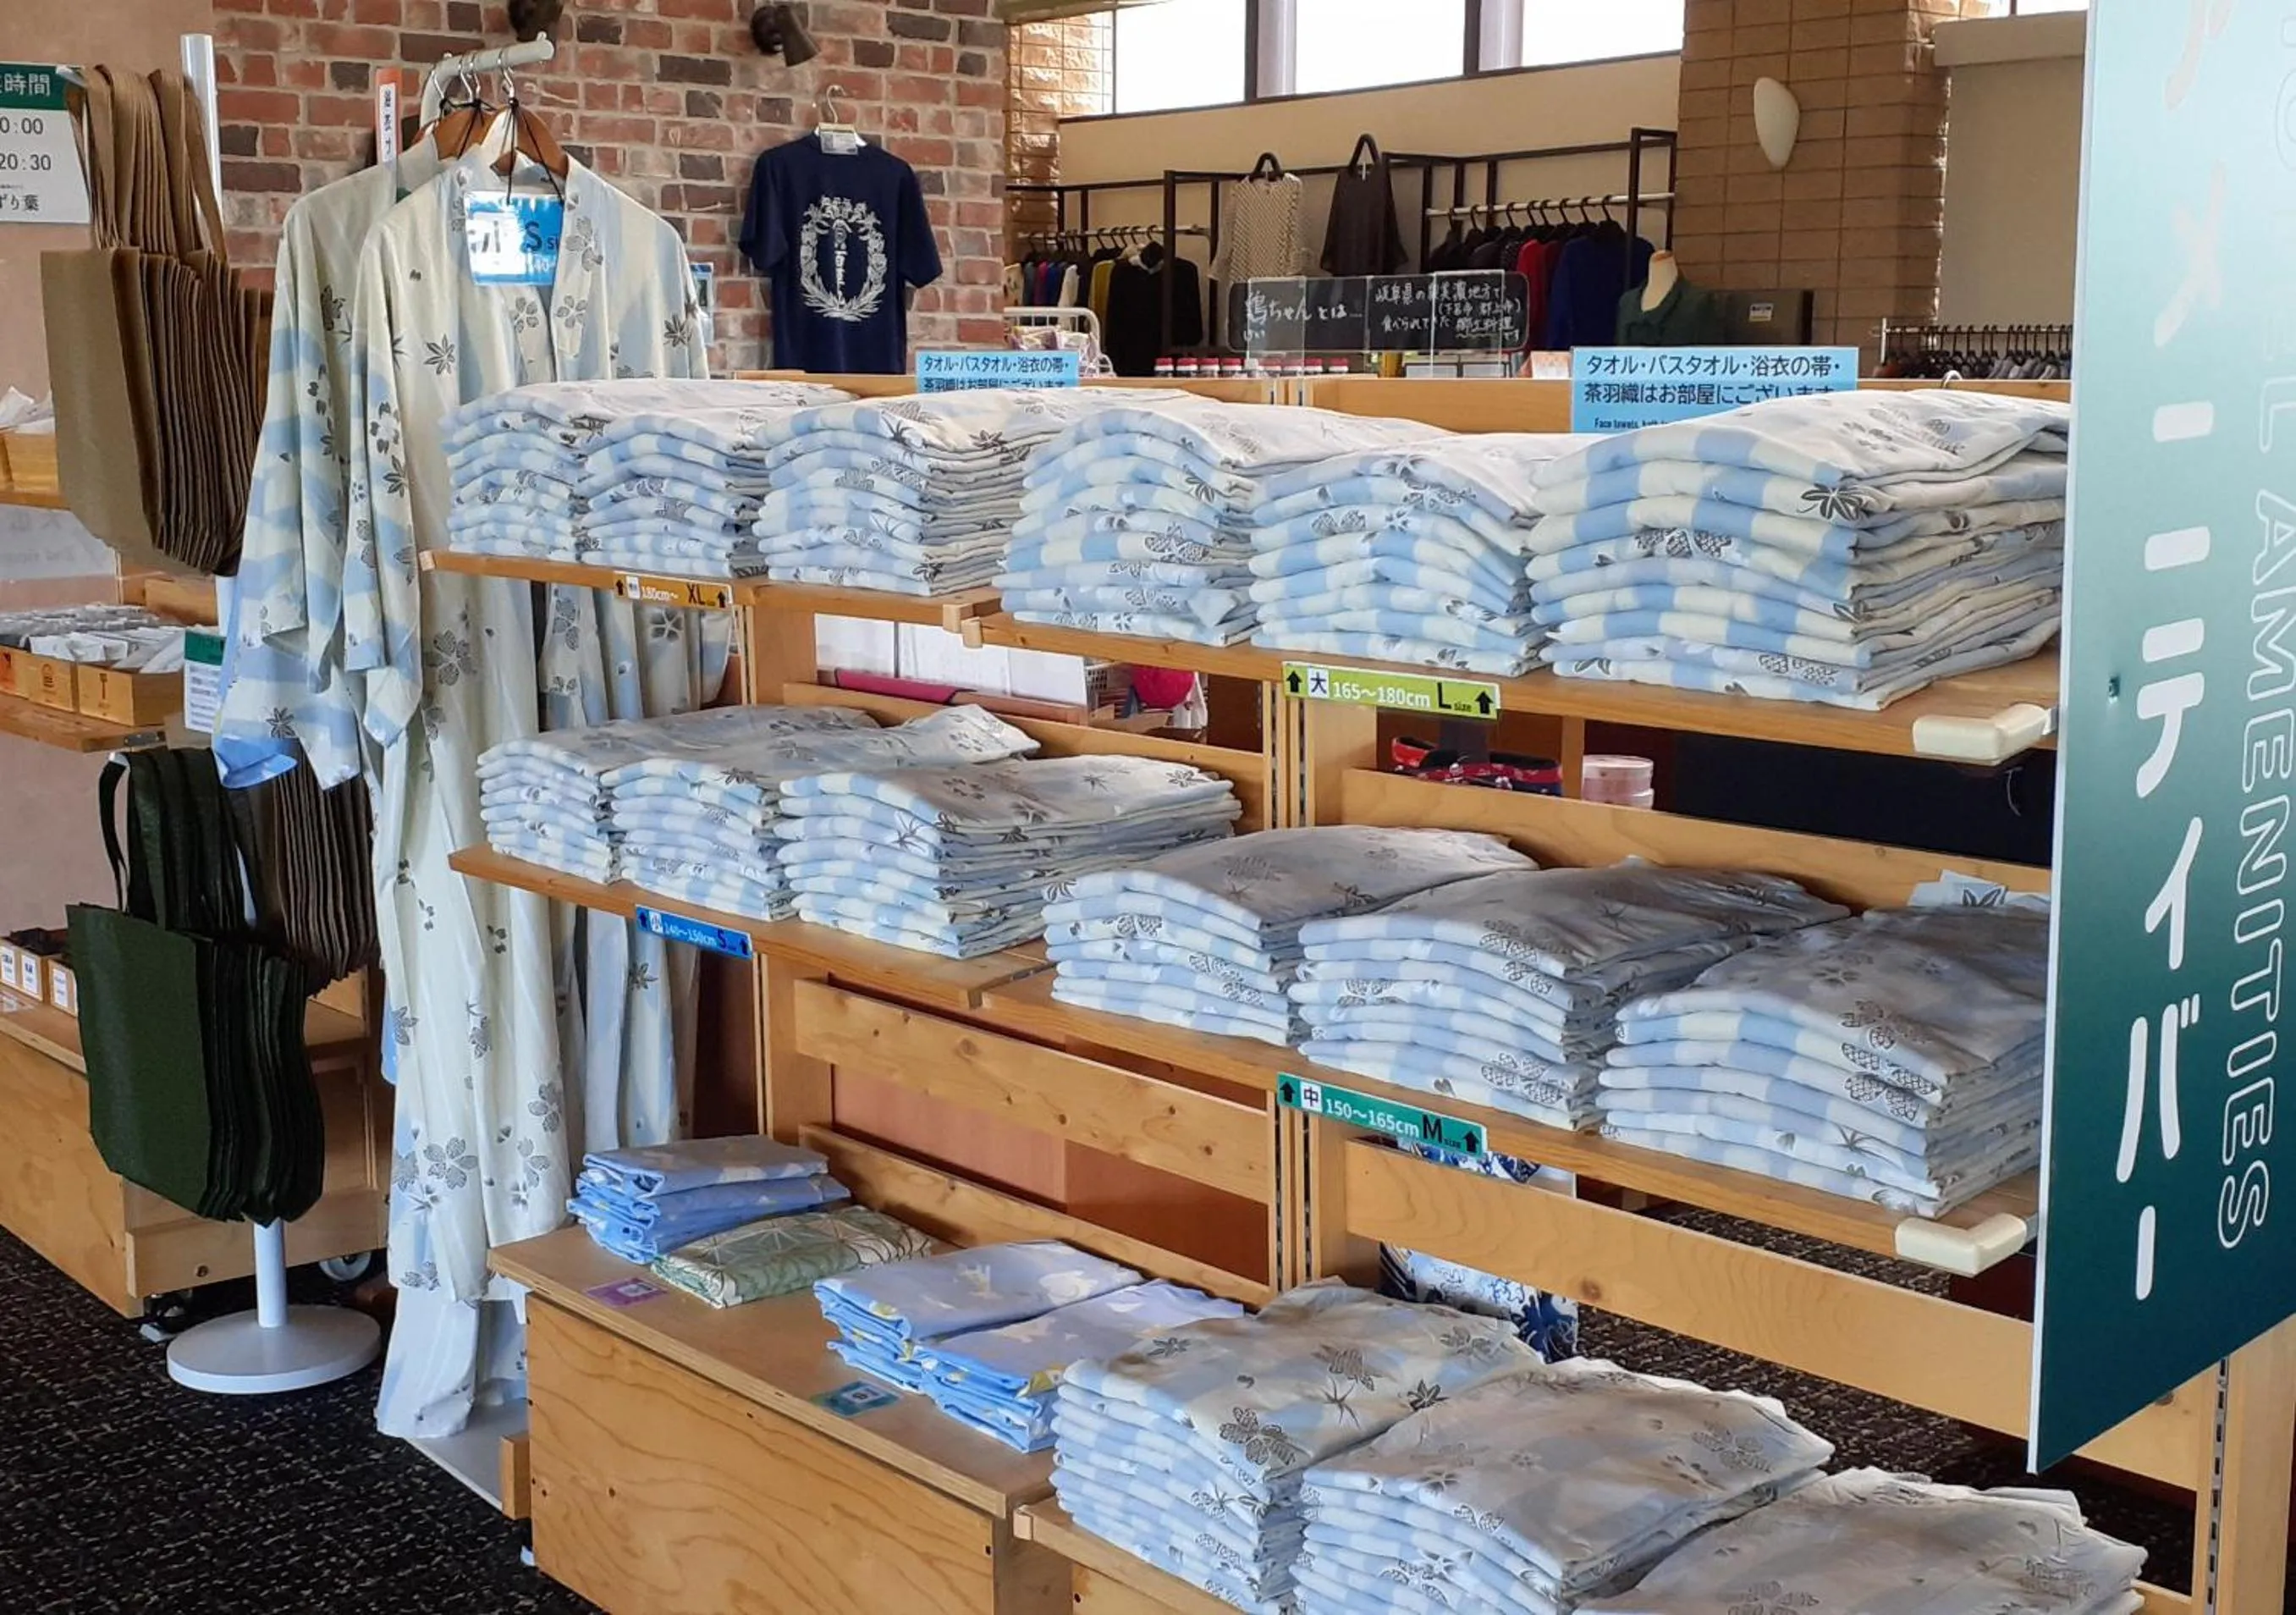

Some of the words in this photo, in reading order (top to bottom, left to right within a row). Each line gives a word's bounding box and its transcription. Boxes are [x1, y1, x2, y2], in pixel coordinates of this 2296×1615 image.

[0, 73, 51, 96] 時間
[686, 582, 706, 605] XL
[1311, 672, 1327, 695] 大
[1437, 682, 1452, 709] L
[2218, 488, 2296, 1248] AMENITIES
[1303, 1086, 1319, 1107] 中
[1423, 1114, 1444, 1144] M
